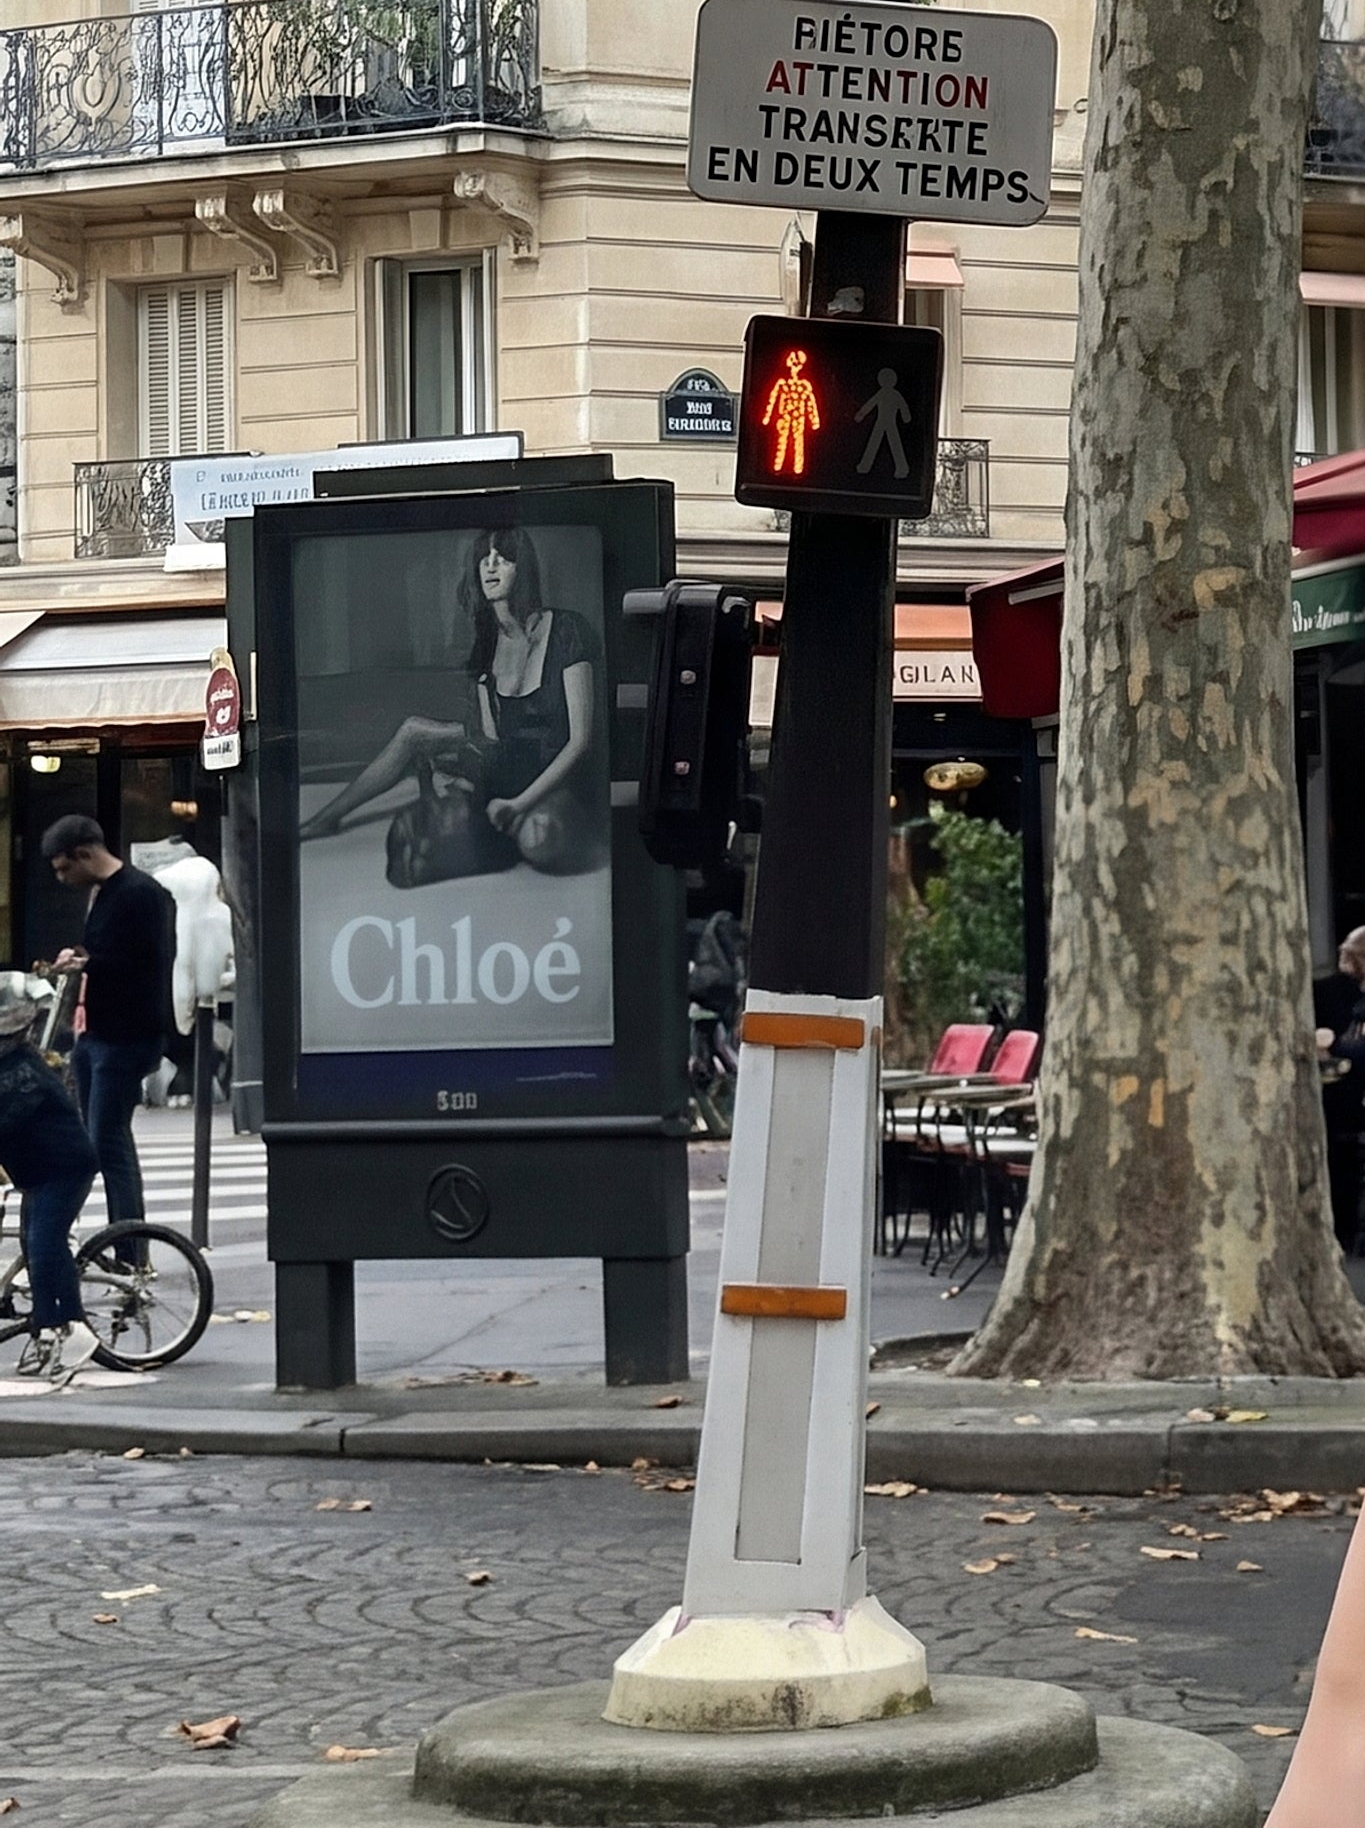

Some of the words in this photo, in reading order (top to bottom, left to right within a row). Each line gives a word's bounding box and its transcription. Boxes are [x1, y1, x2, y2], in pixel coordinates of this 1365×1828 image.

[766, 60, 988, 109] ATTENTION
[707, 146, 758, 183] EN
[774, 151, 880, 193] DEUX
[896, 161, 1029, 204] TEMPS
[331, 915, 581, 1009] Chloé
